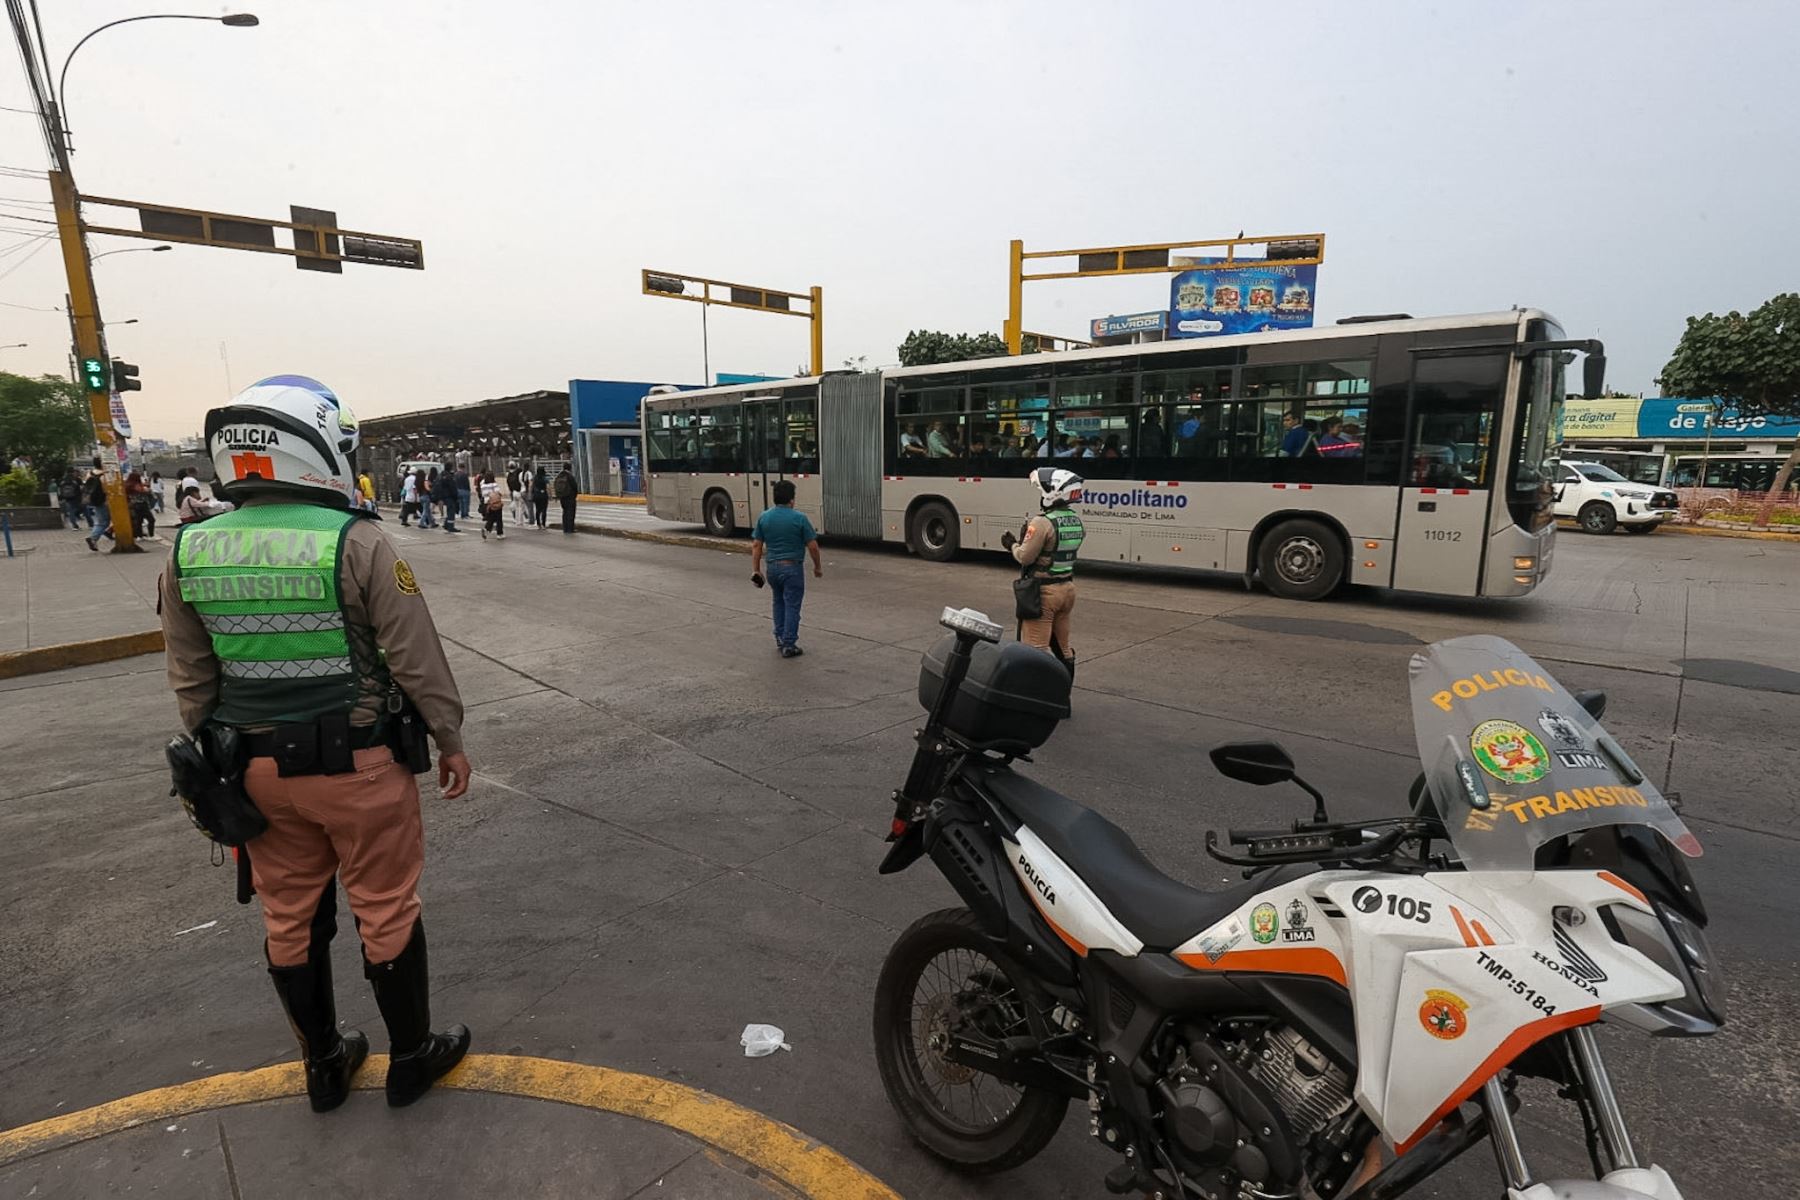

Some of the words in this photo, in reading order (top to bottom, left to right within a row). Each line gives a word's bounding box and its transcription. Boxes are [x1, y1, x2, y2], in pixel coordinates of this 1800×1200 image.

[1099, 318, 1160, 332] SALVADOR
[1578, 411, 1617, 423] digital
[1669, 414, 1697, 429] de
[217, 428, 280, 445] POLICIA
[1081, 489, 1188, 509] tropolitano
[1424, 530, 1462, 542] 11012
[186, 530, 318, 566] POLICIA
[183, 575, 322, 600] TRANSITO
[1430, 668, 1555, 712] POLICIA
[1559, 753, 1609, 770] LIMA
[1504, 786, 1649, 823] TRANSITO
[1019, 854, 1056, 906] POLICÍA
[1386, 894, 1432, 924] 105
[1282, 931, 1315, 942] LIMA
[1475, 951, 1557, 1017] TMP:5184
[1531, 951, 1600, 998] HONDA
